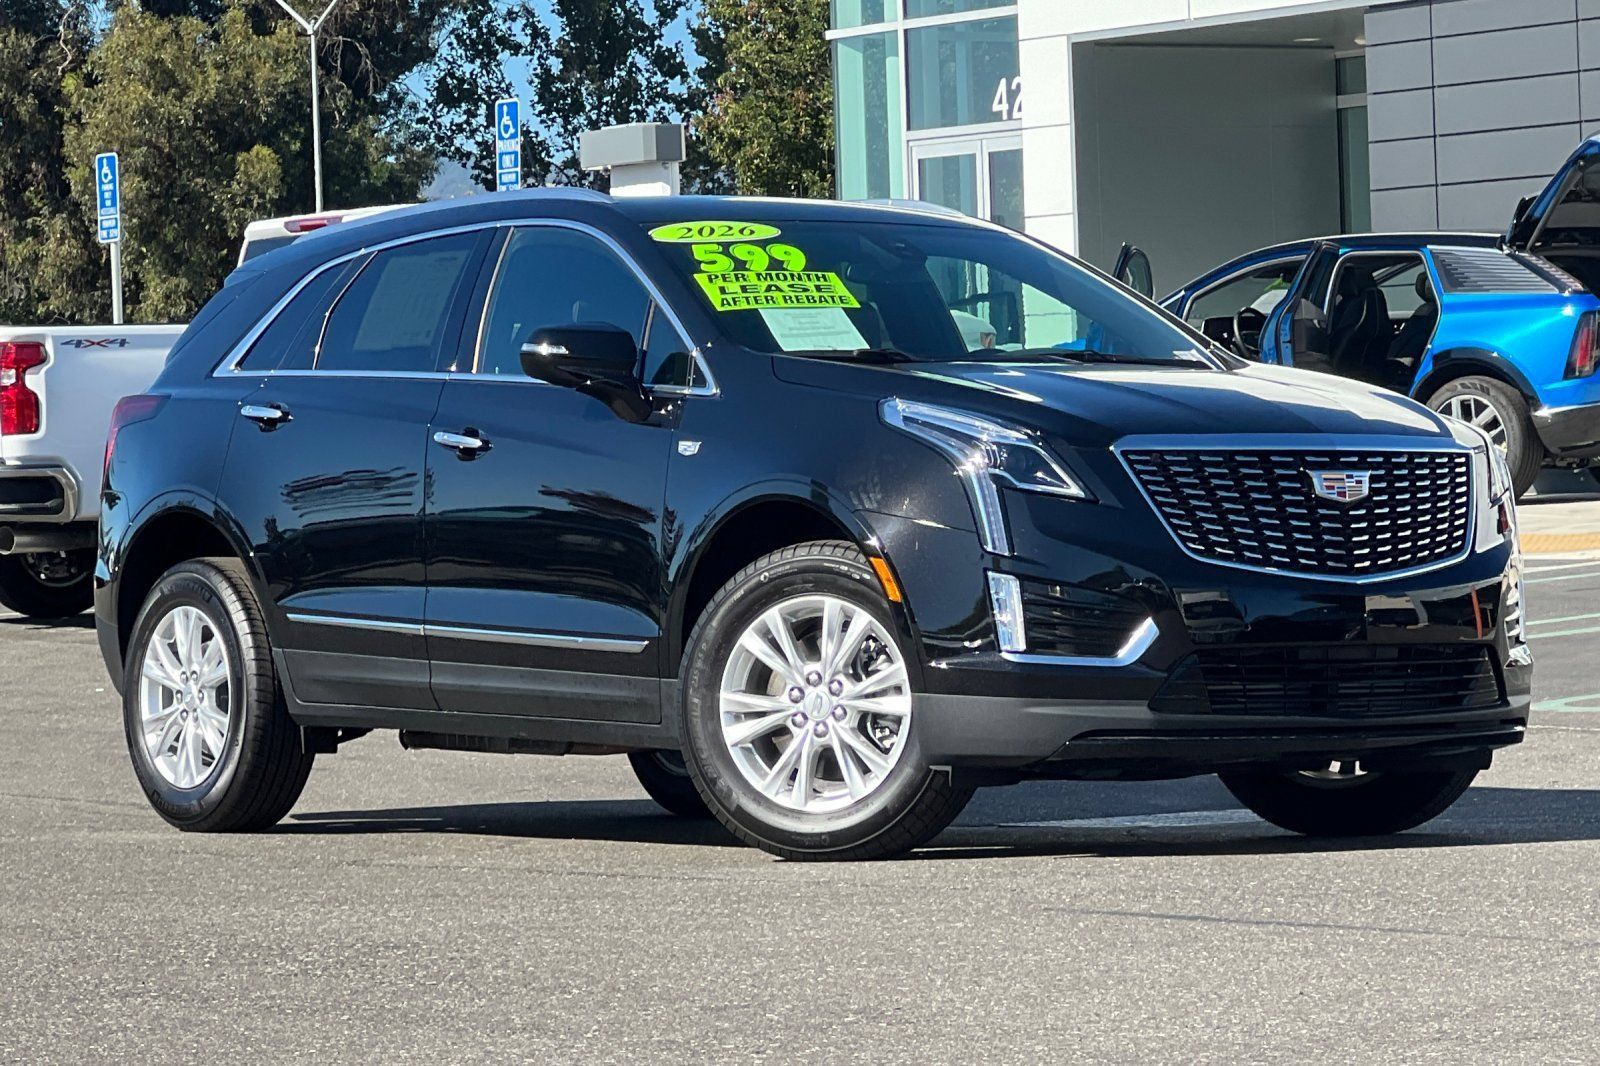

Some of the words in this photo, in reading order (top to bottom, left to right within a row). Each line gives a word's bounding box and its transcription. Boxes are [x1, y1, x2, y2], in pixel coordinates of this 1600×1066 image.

[679, 225, 755, 239] 2026
[691, 243, 807, 272] 599
[707, 272, 749, 284] PER
[755, 272, 828, 283] MONTH
[718, 283, 836, 294] LEASE
[720, 295, 780, 307] AFTER
[783, 294, 849, 305] REBATE
